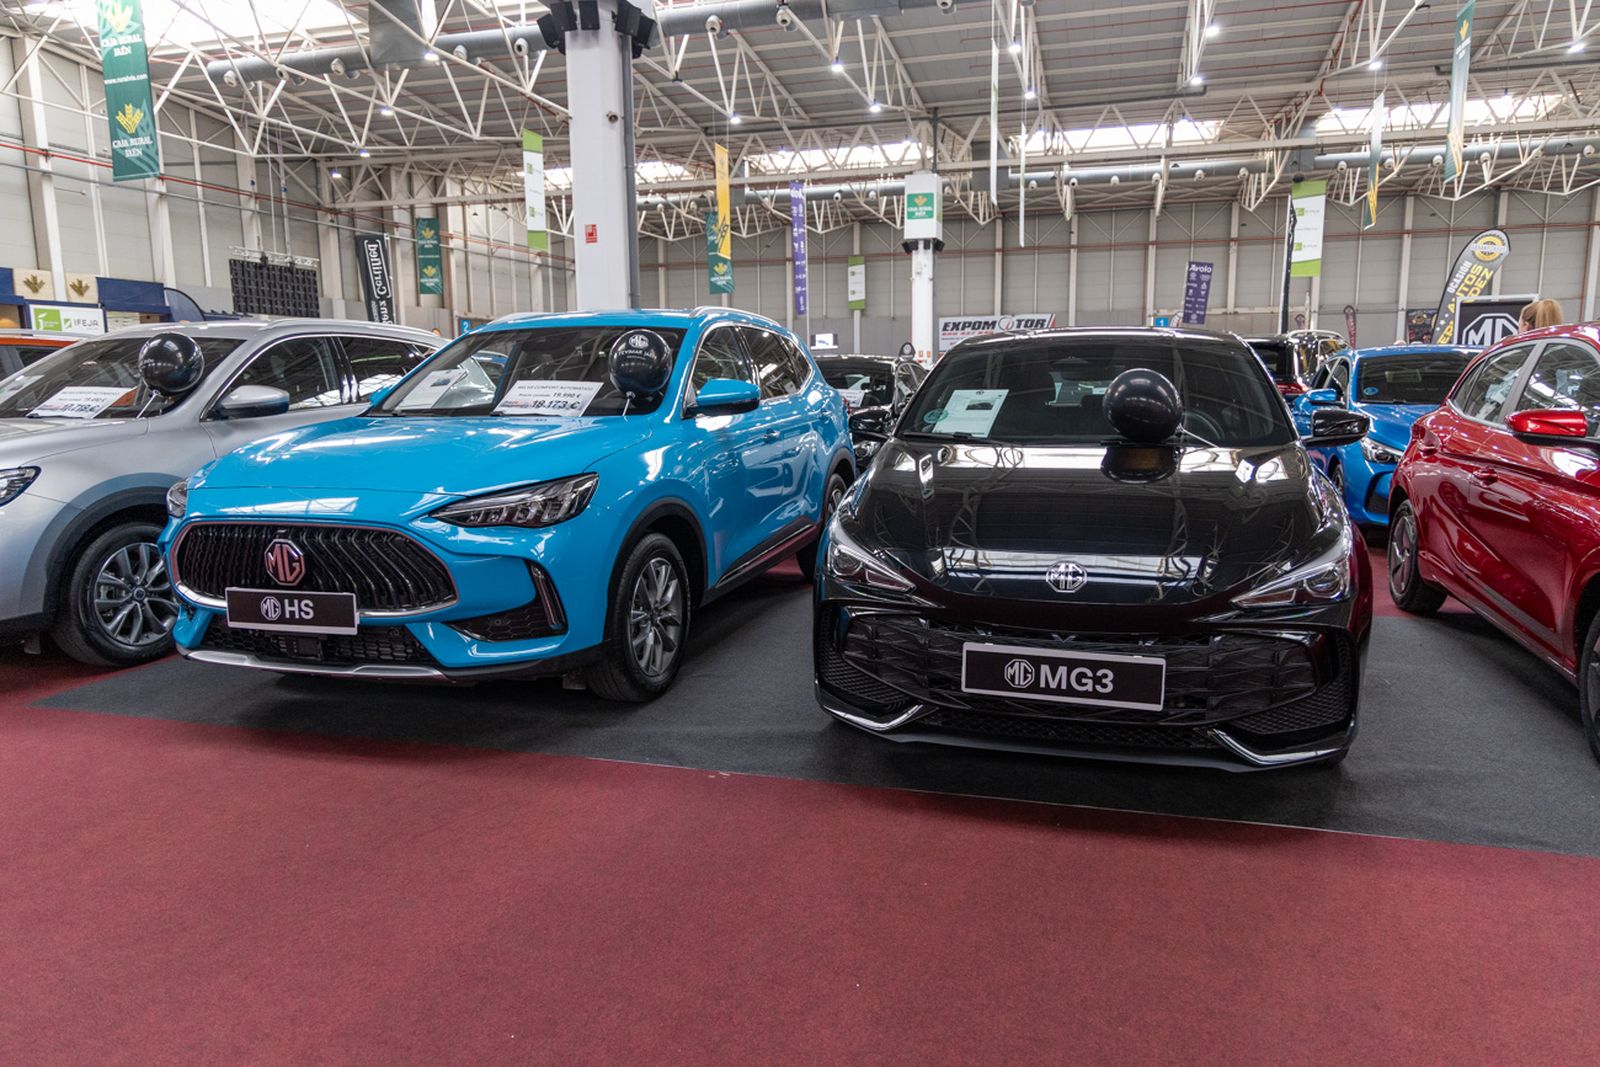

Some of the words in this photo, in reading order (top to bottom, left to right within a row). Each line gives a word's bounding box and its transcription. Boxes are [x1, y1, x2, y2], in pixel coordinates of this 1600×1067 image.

[532, 399, 568, 409] 18.173
[570, 400, 580, 410] €
[266, 541, 303, 584] MG
[1048, 561, 1085, 591] MG
[262, 597, 281, 619] MG
[283, 599, 315, 620] HS
[1006, 659, 1033, 687] MG
[1039, 664, 1115, 693] MG3
